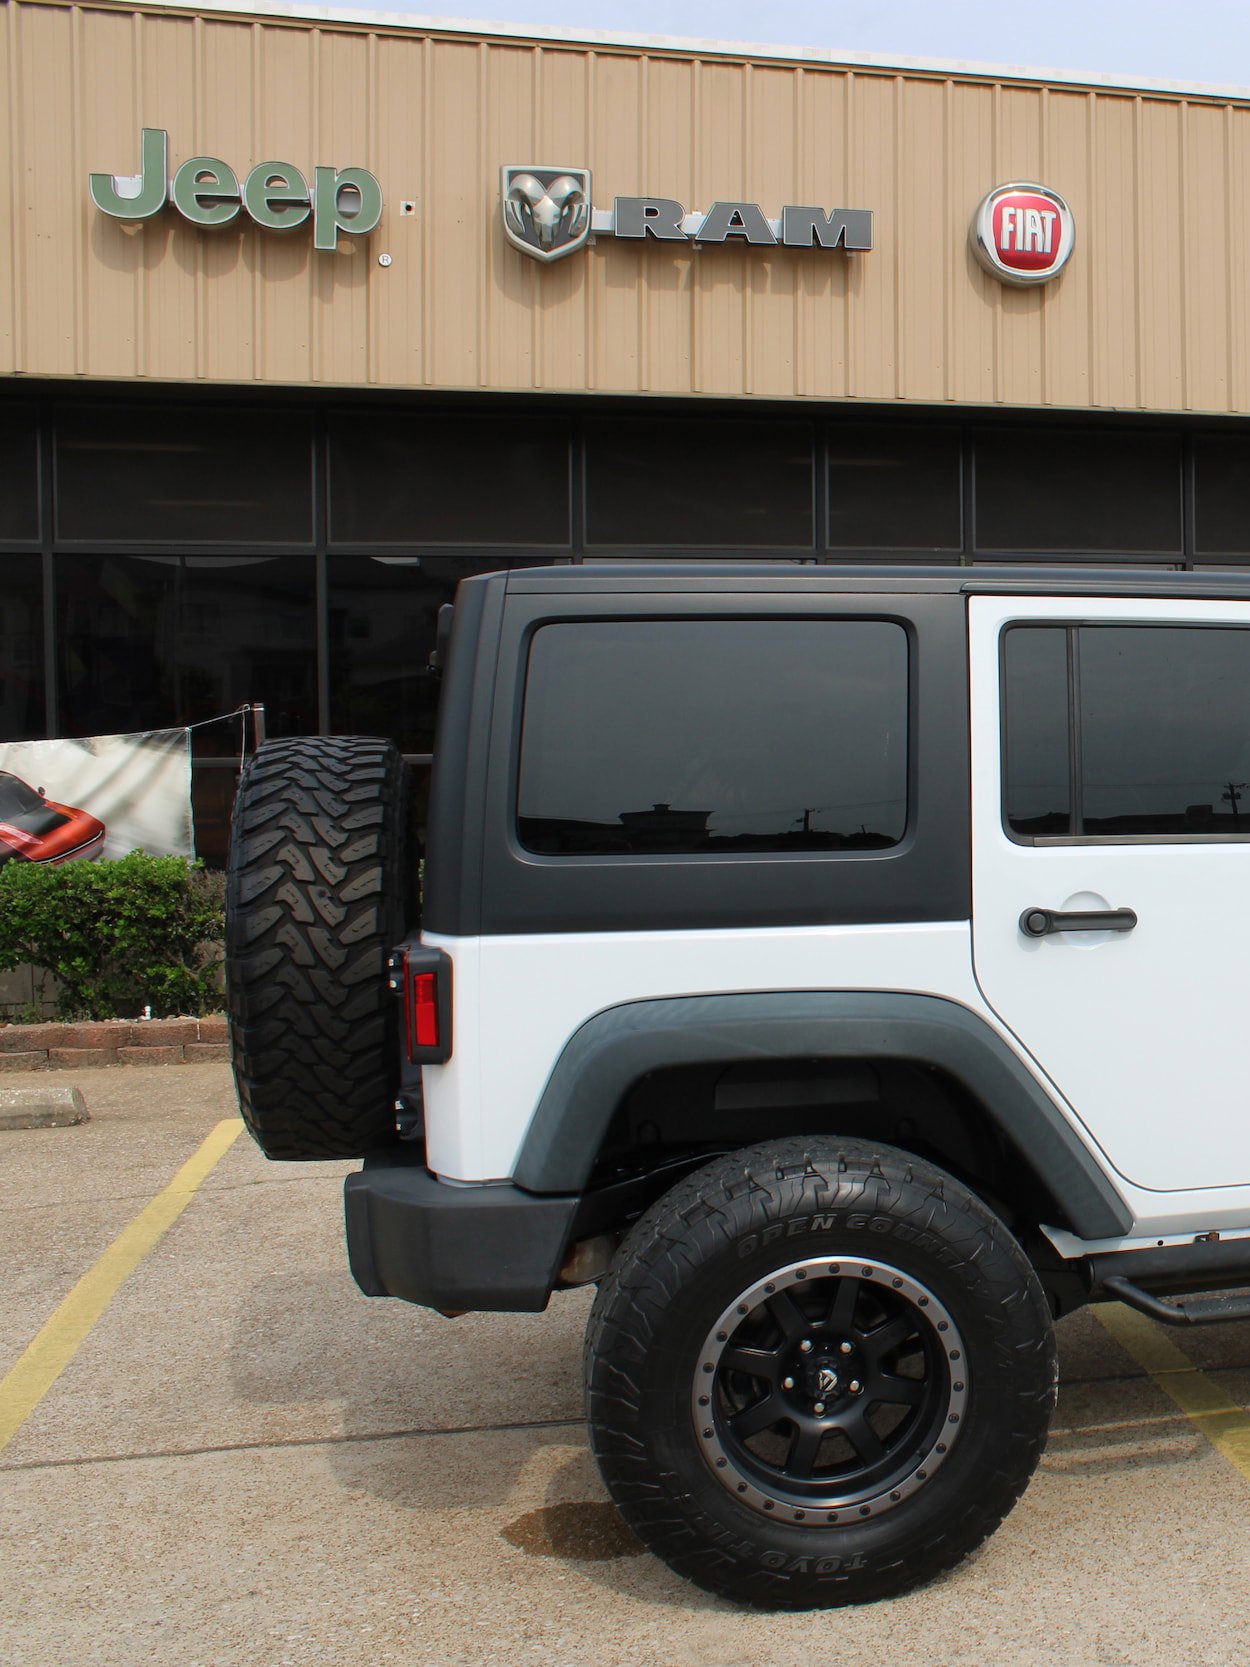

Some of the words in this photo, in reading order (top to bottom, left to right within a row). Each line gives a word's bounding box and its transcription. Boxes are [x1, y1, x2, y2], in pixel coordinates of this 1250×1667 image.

[89, 128, 383, 250] Jeep
[614, 197, 874, 250] RAM
[1001, 207, 1056, 253] FIAT
[736, 1213, 839, 1259] OPEN
[759, 1550, 868, 1574] TOYO
